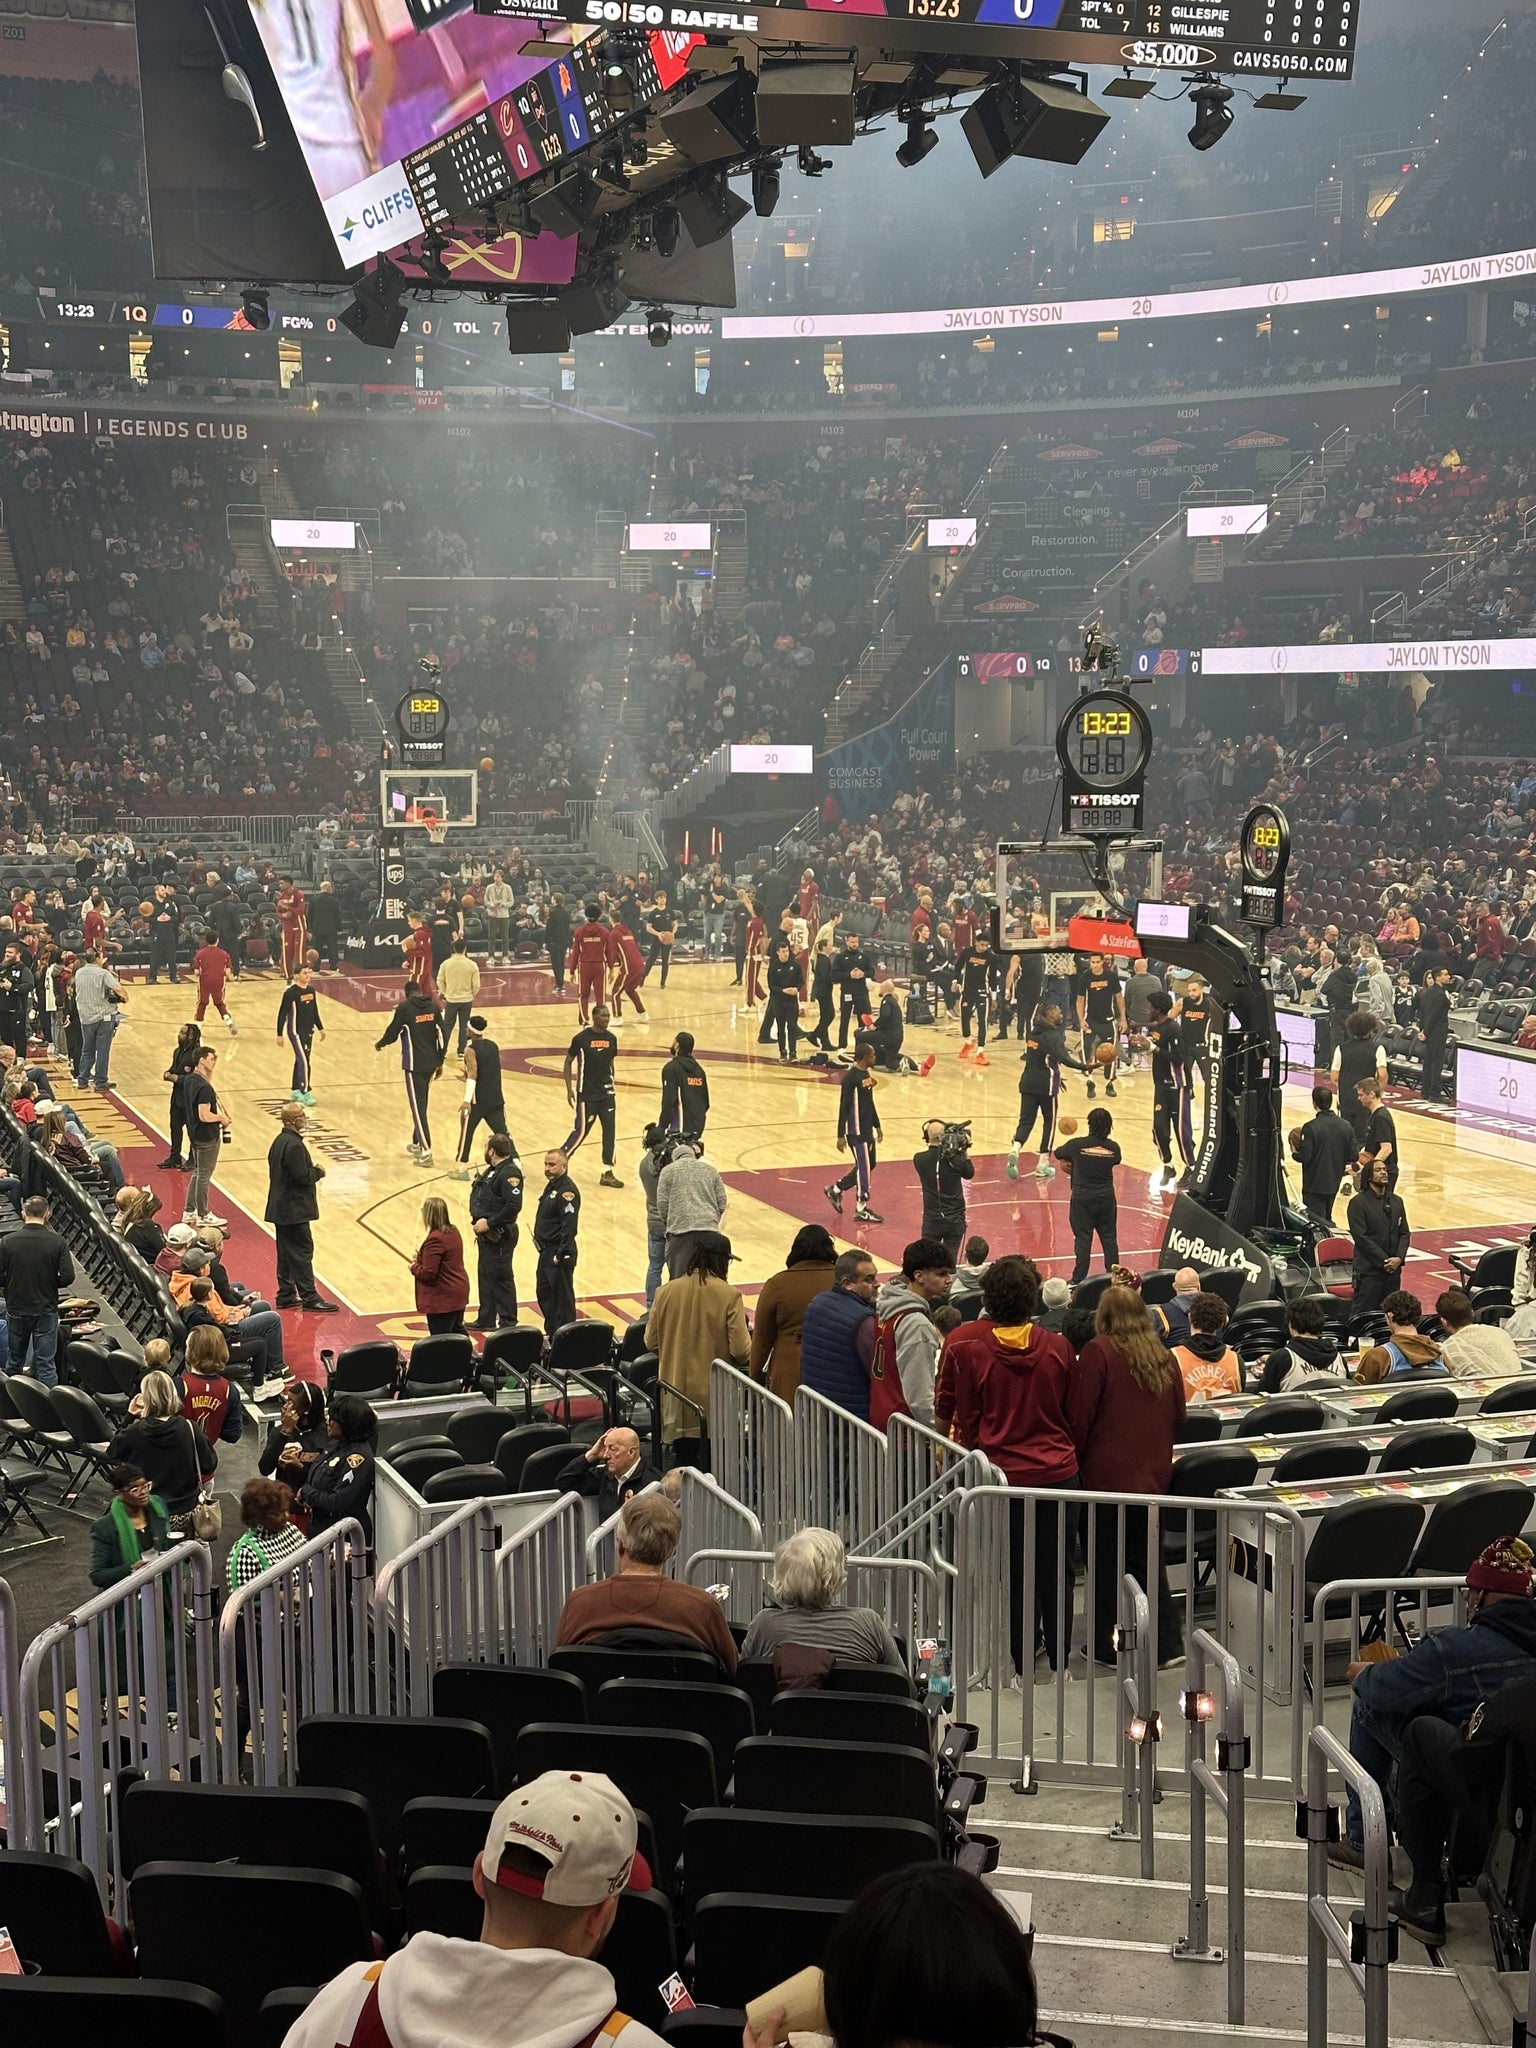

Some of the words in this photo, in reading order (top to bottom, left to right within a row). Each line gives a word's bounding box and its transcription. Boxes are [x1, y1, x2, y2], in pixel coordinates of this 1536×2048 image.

[1116, 3, 1125, 15] 0
[1147, 5, 1162, 17] 12
[1171, 6, 1230, 21] GILLESPIE
[671, 8, 759, 31] RAFFLE
[1080, 17, 1101, 29] TOL
[1122, 20, 1130, 32] 7
[1146, 22, 1160, 34] 15
[1170, 23, 1224, 38] WILLIAMS
[1132, 41, 1199, 65] $5,000
[1234, 51, 1348, 73] CAVS5050.COM
[568, 113, 582, 141] 0
[540, 132, 562, 162] 13:23
[517, 142, 528, 169] 0
[362, 187, 414, 229] CLIFFS
[1421, 261, 1482, 285] JAYLON
[1486, 253, 1536, 276] TYSON
[57, 303, 95, 318] 13:23
[122, 306, 148, 323] 1Q
[1131, 299, 1153, 316] 20
[181, 308, 193, 326] 0
[282, 316, 314, 330] FG%
[326, 318, 337, 332] 0
[944, 310, 1004, 328] JAYLON
[1009, 306, 1063, 325] TYSON
[422, 320, 432, 335] 0
[453, 321, 481, 334] TOL
[491, 321, 502, 336] 7
[1177, 408, 1200, 420] M104
[820, 425, 845, 436] M103
[1220, 515, 1234, 527] 20
[307, 528, 321, 540] 20
[663, 531, 677, 542] 20
[946, 527, 959, 538] 20
[1138, 654, 1148, 672] 0
[1386, 647, 1438, 667] JAYLON
[1442, 644, 1491, 666] TYSON
[961, 664, 968, 675] 0
[1016, 656, 1027, 674] 0
[1036, 659, 1050, 671] 1Q
[1191, 661, 1199, 673] 0
[410, 699, 439, 713] 13:23
[1082, 712, 1131, 735] 13:23
[901, 728, 919, 744] Full
[920, 729, 948, 745] Court
[414, 742, 444, 750] TISSOT
[764, 753, 778, 764] 20
[908, 747, 941, 762] Power
[828, 767, 883, 777] COMCAST
[829, 778, 883, 789] BUSINESS
[1089, 794, 1140, 806] TISSOT
[1254, 827, 1280, 847] 13:23
[388, 871, 403, 882] ups
[1252, 886, 1277, 897] TISSOT
[1159, 914, 1168, 926] 20
[1499, 1076, 1519, 1100] 20
[1209, 1061, 1220, 1140] Cleveland
[1167, 1227, 1229, 1269] KeyBank
[191, 1395, 222, 1411] MOBLEY
[509, 1820, 540, 1840] Mitchell
